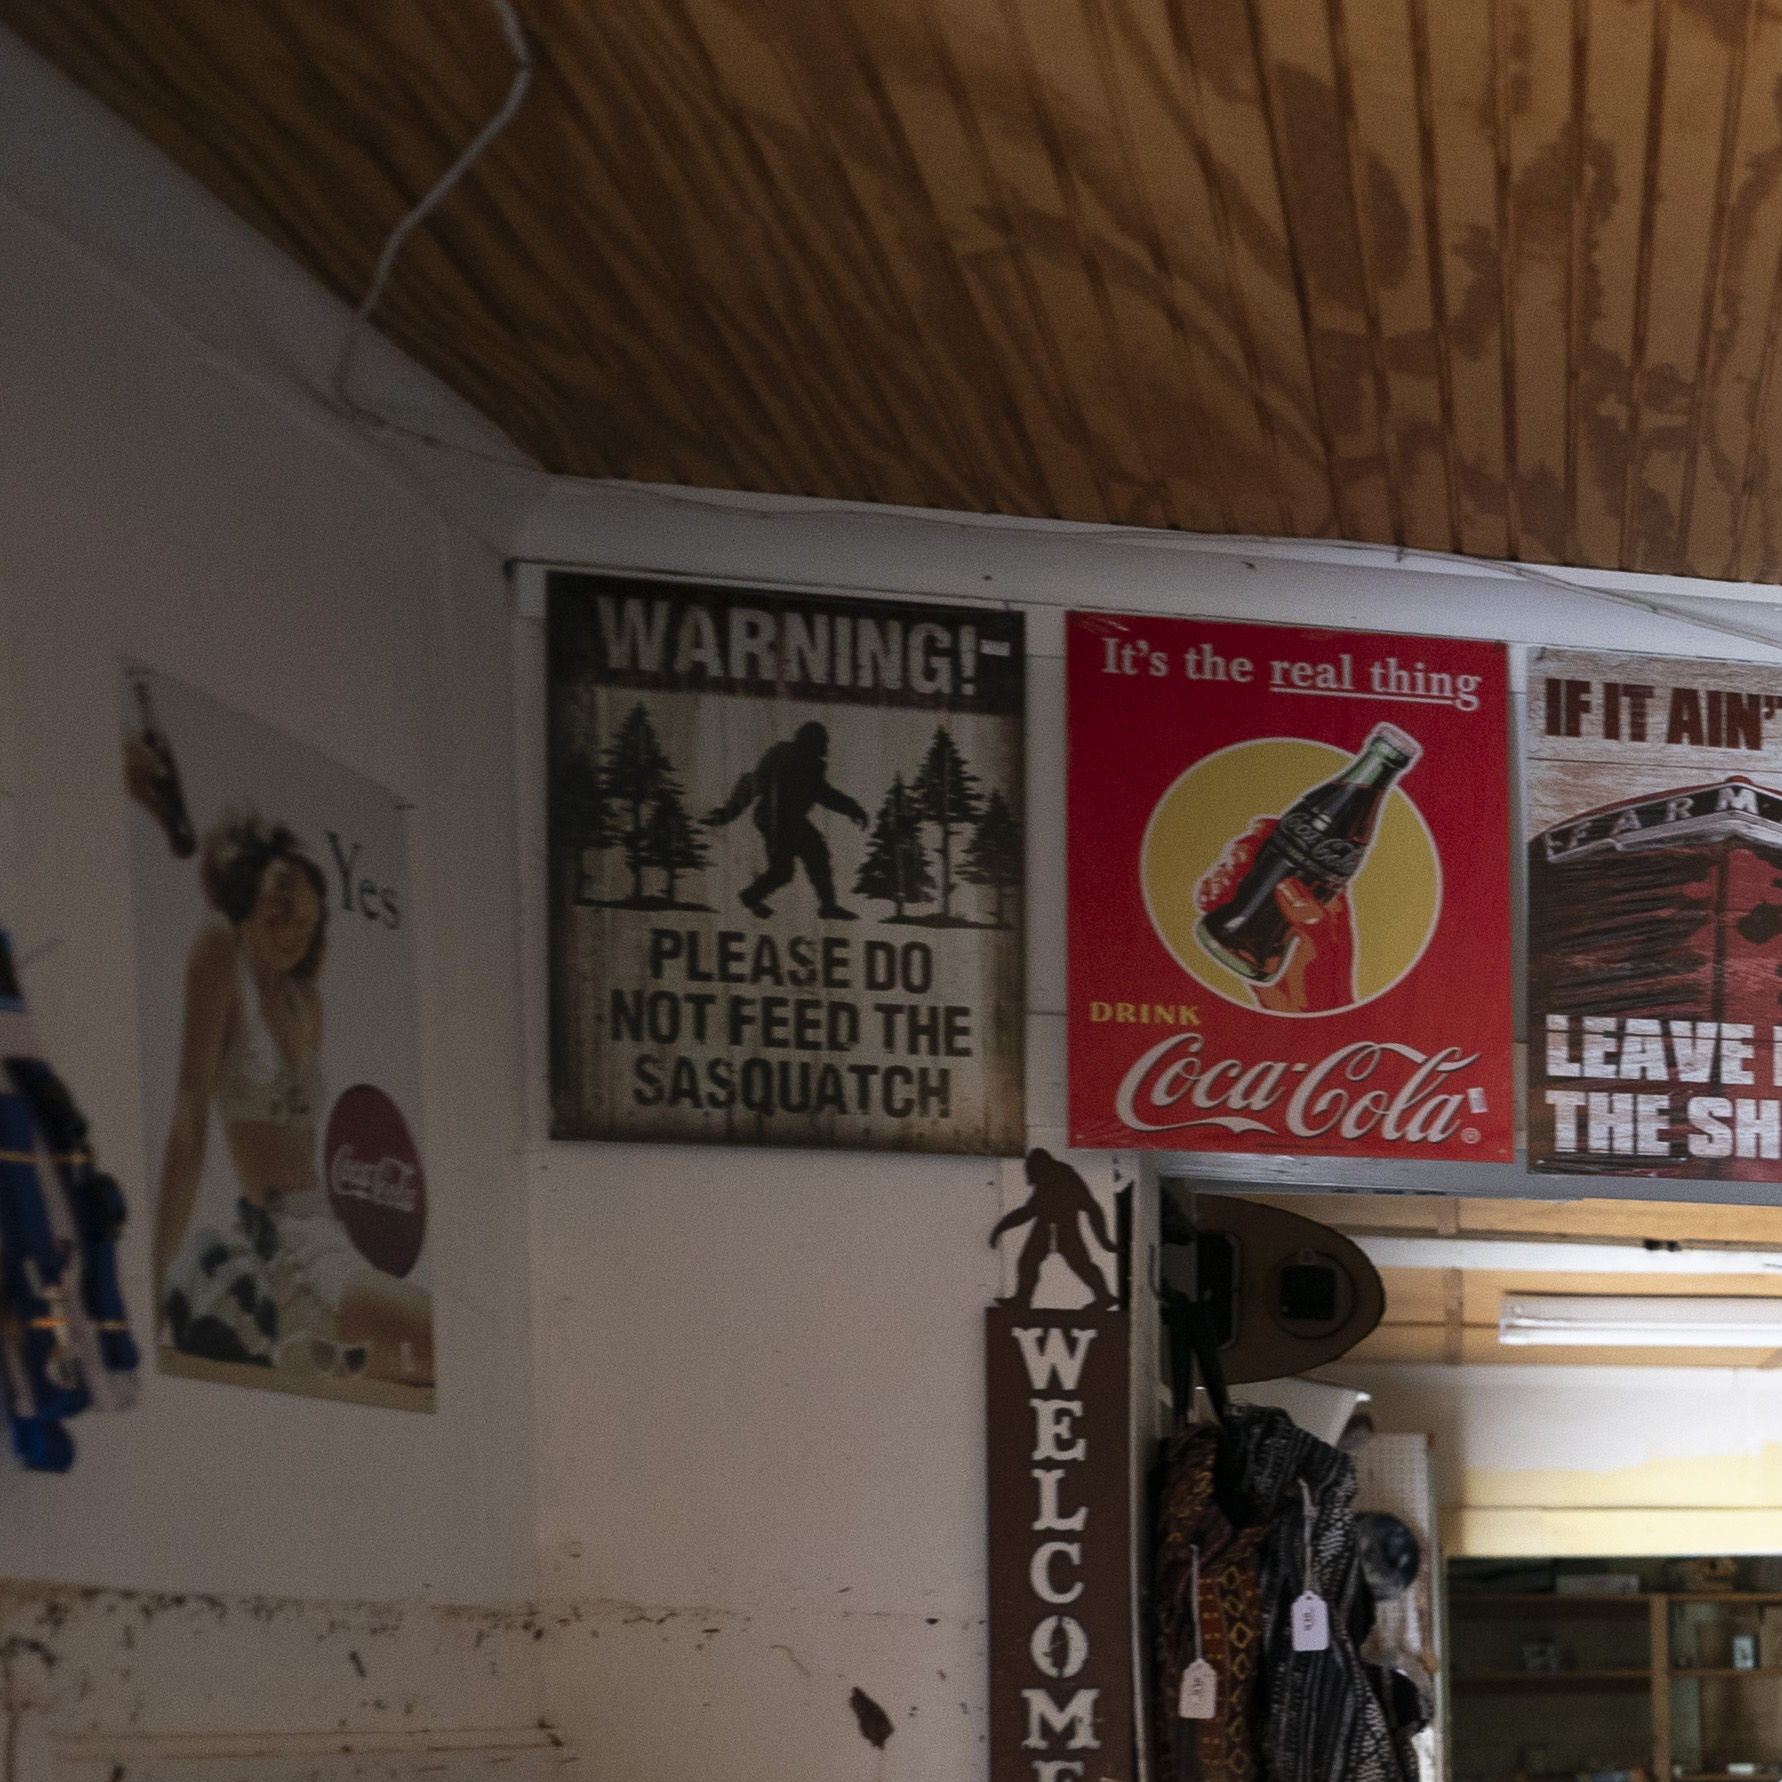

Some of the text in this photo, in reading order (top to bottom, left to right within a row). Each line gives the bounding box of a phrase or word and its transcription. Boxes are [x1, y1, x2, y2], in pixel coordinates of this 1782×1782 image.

[600, 597, 978, 695] WARNING!
[1102, 636, 1481, 711] It's the real thing
[1545, 677, 1592, 738] IF
[1603, 681, 1654, 742] IT
[325, 829, 402, 930] Yes
[649, 927, 933, 995] PLEASE DO
[610, 989, 973, 1057] NOT FEED THE
[1089, 1000, 1201, 1025] DRINK
[1545, 1014, 1755, 1085] LEAVE
[634, 1053, 951, 1120] SASQUATCH
[1115, 1031, 1481, 1143] Coca-Cola
[1545, 1089, 1672, 1156] THE
